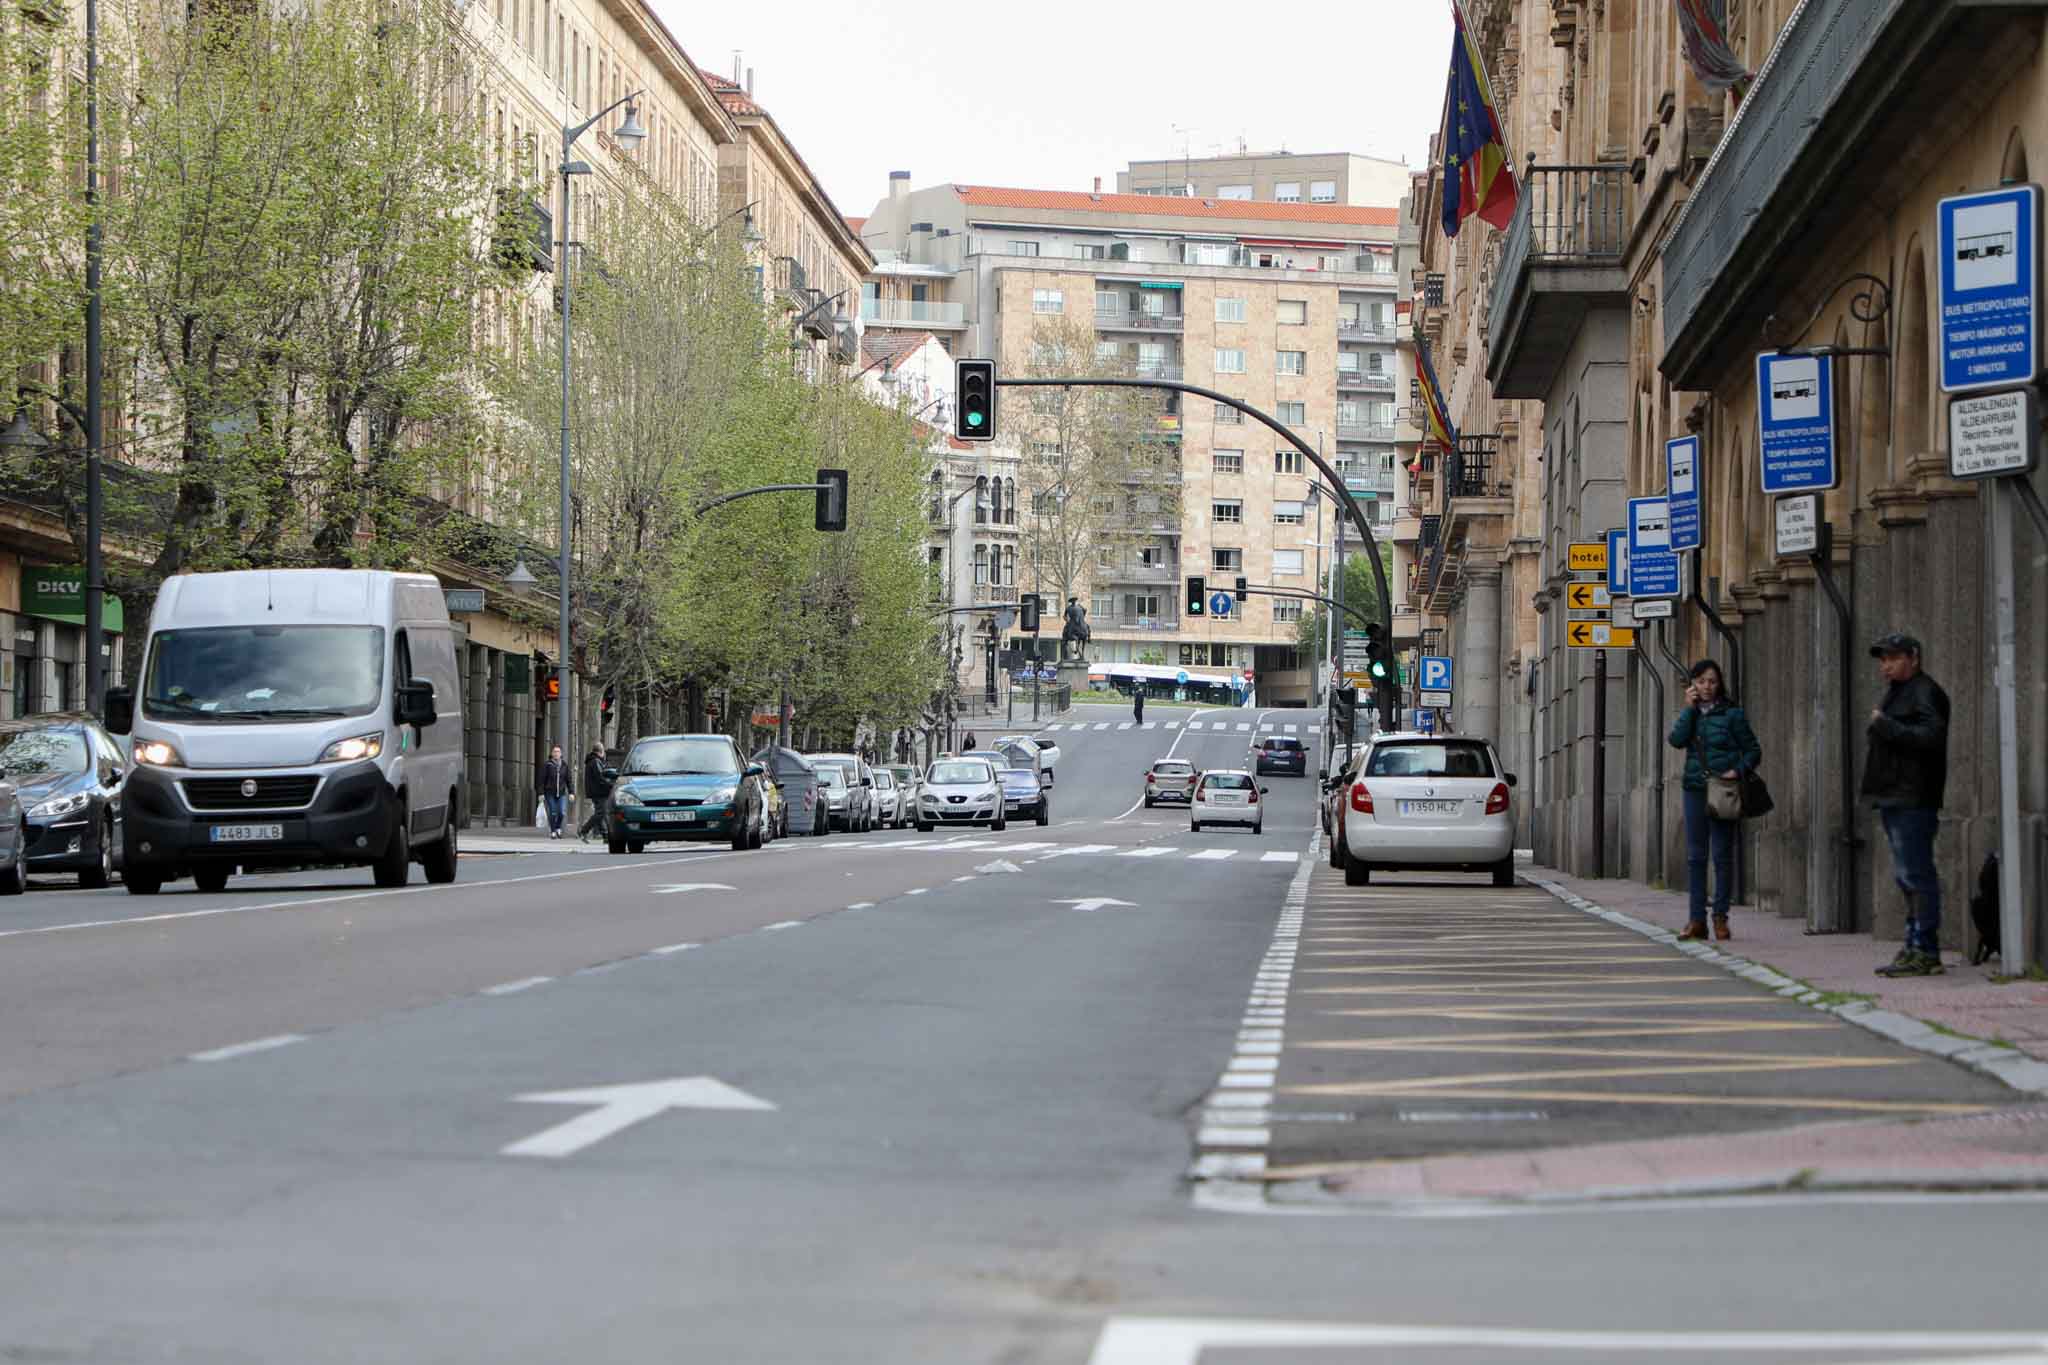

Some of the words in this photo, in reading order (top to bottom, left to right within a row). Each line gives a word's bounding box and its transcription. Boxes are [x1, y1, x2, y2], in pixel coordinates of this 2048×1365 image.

[1945, 305, 1962, 317] BUS
[1963, 296, 2030, 314] METROPOLITANO
[2008, 325, 2025, 336] CON
[1572, 551, 1604, 562] hotel
[36, 581, 80, 592] DKV
[1426, 661, 1446, 686] P
[1411, 803, 1434, 811] 1350
[1437, 803, 1457, 811] HLZ
[219, 827, 250, 839] 4483
